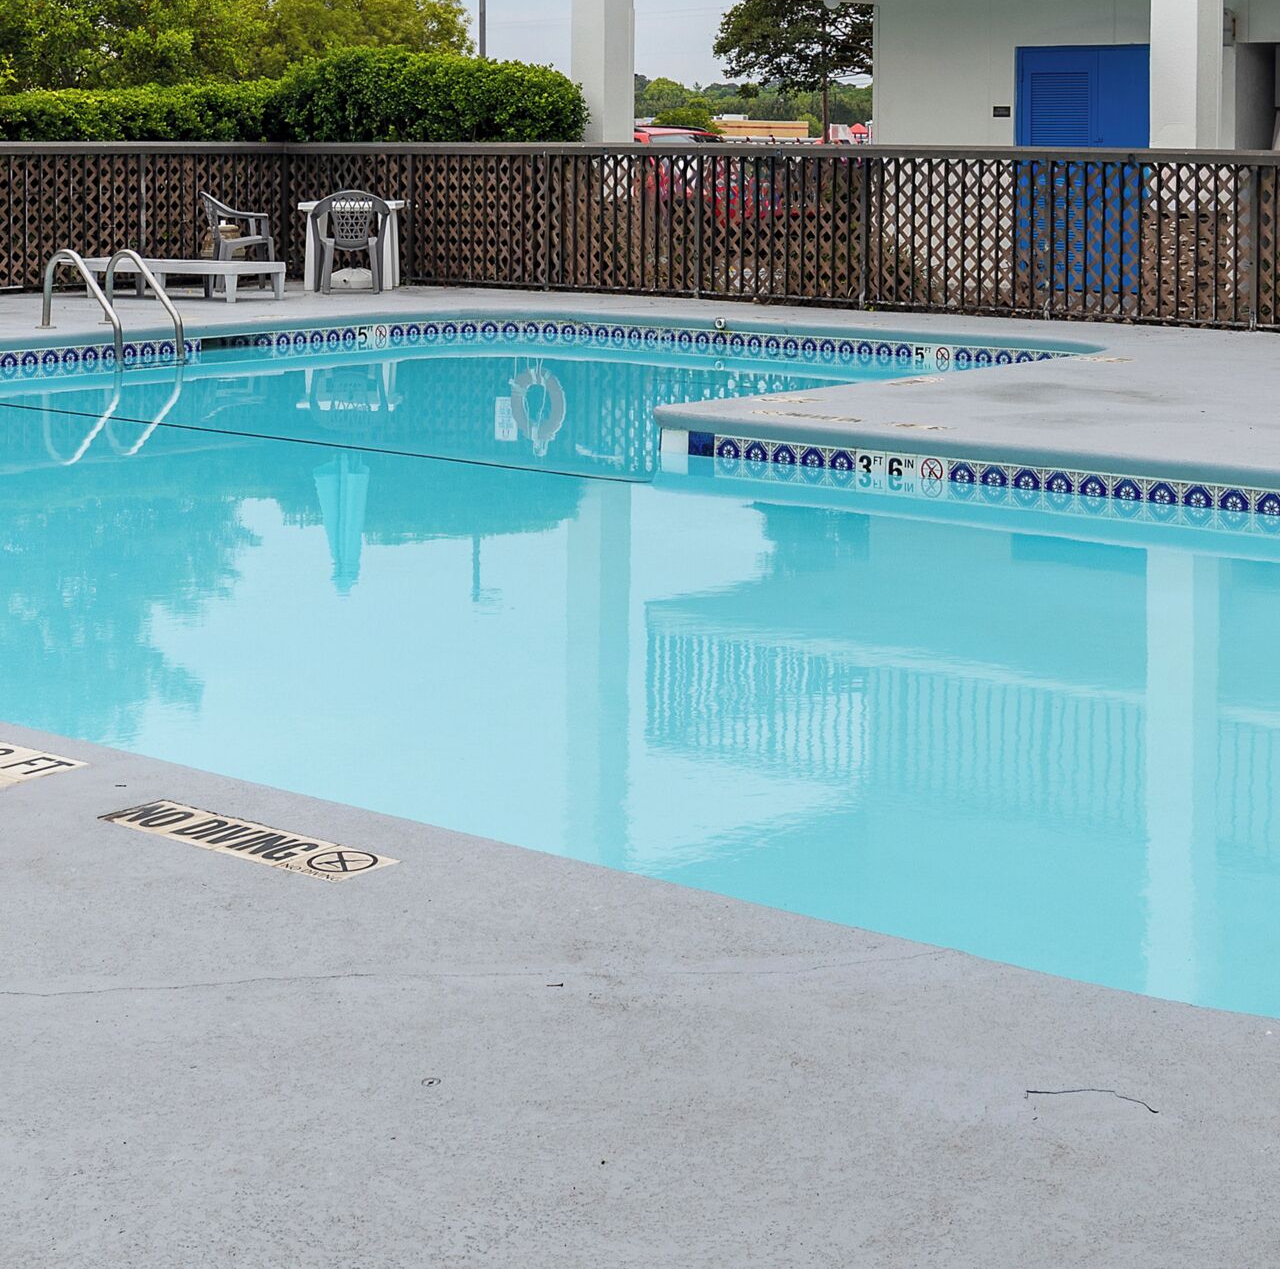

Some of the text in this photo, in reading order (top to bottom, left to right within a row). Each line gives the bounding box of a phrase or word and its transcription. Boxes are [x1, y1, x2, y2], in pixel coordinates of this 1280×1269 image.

[358, 326, 367, 342] 5
[915, 347, 924, 360] 5
[858, 455, 914, 477] 3 FT 6 IN
[0, 757, 75, 775] FT
[125, 805, 319, 862] NO DIVING
